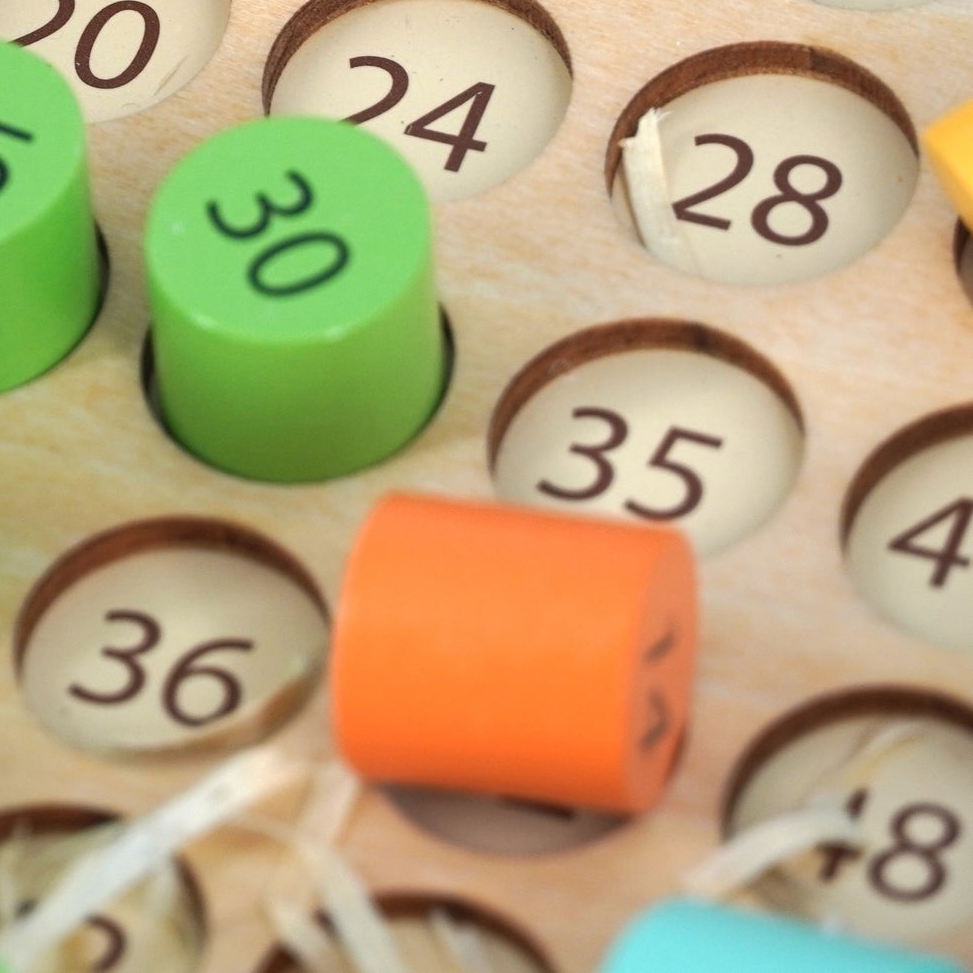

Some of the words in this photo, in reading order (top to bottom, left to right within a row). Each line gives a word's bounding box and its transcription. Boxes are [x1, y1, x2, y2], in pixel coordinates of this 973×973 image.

[339, 55, 496, 174] 24
[205, 167, 350, 298] 30
[671, 133, 843, 246] 28
[536, 406, 724, 522] 35
[67, 609, 256, 728] 36
